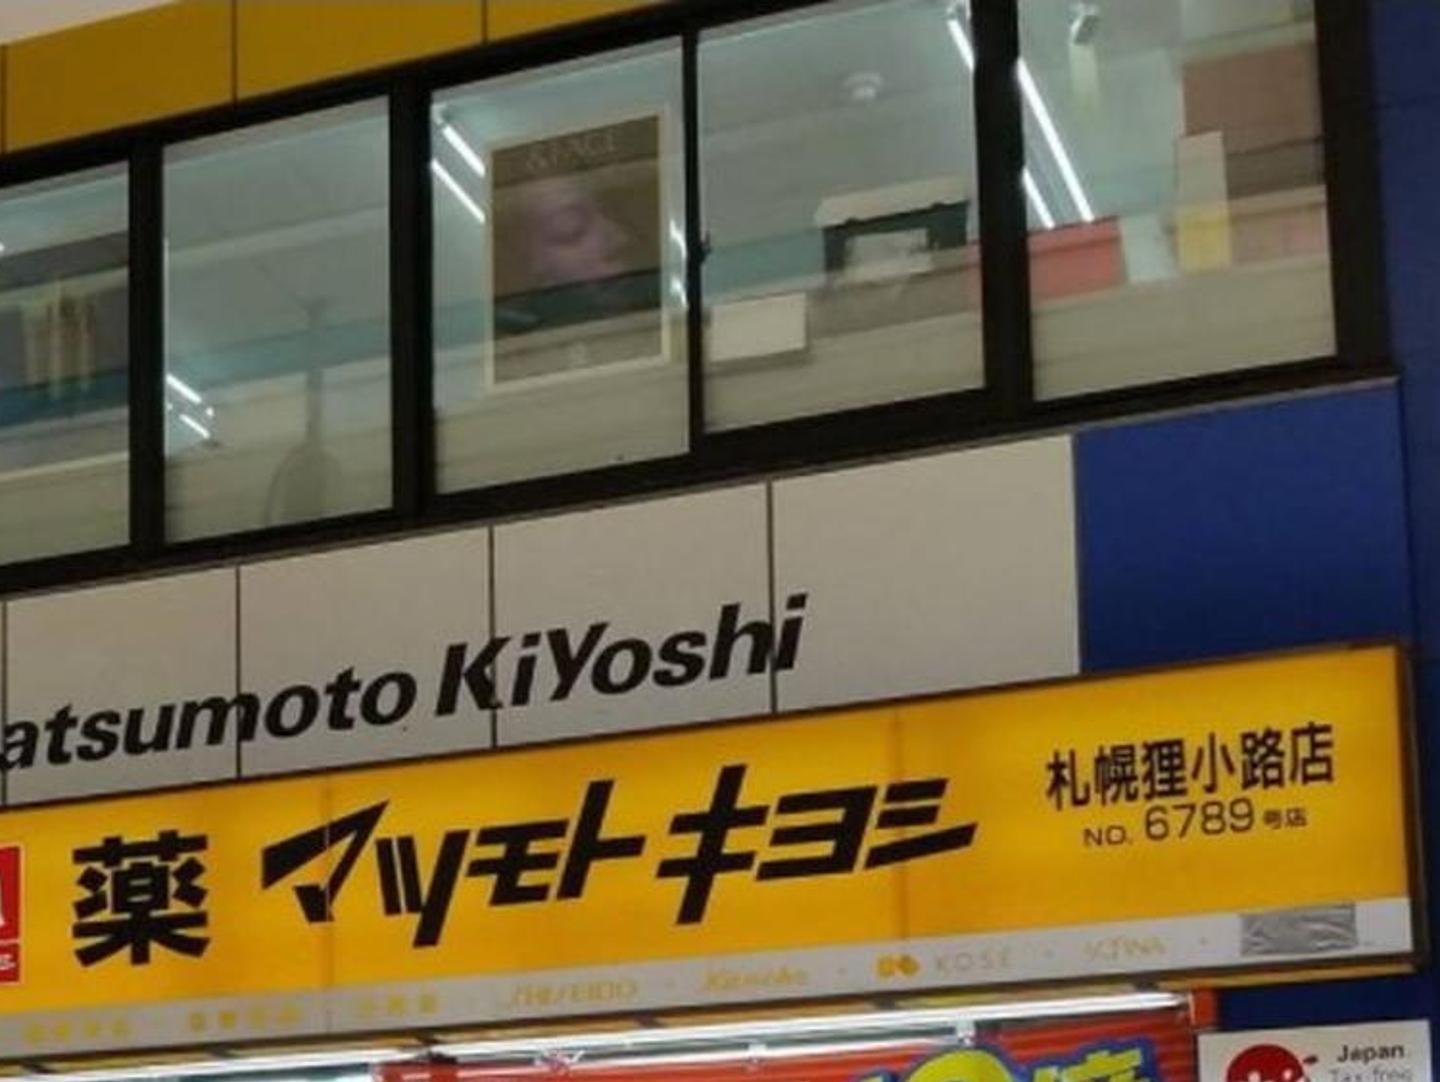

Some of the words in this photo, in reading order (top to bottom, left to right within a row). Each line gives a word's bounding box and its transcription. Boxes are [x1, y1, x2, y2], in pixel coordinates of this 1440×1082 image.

[435, 593, 809, 716] KiYoshi
[1046, 720, 1335, 811] 札幌狸小路店
[1144, 797, 1255, 841] 6789
[71, 829, 210, 967] 薬
[260, 764, 979, 948] マツモトキヨシ
[1337, 1044, 1406, 1064] Japan
